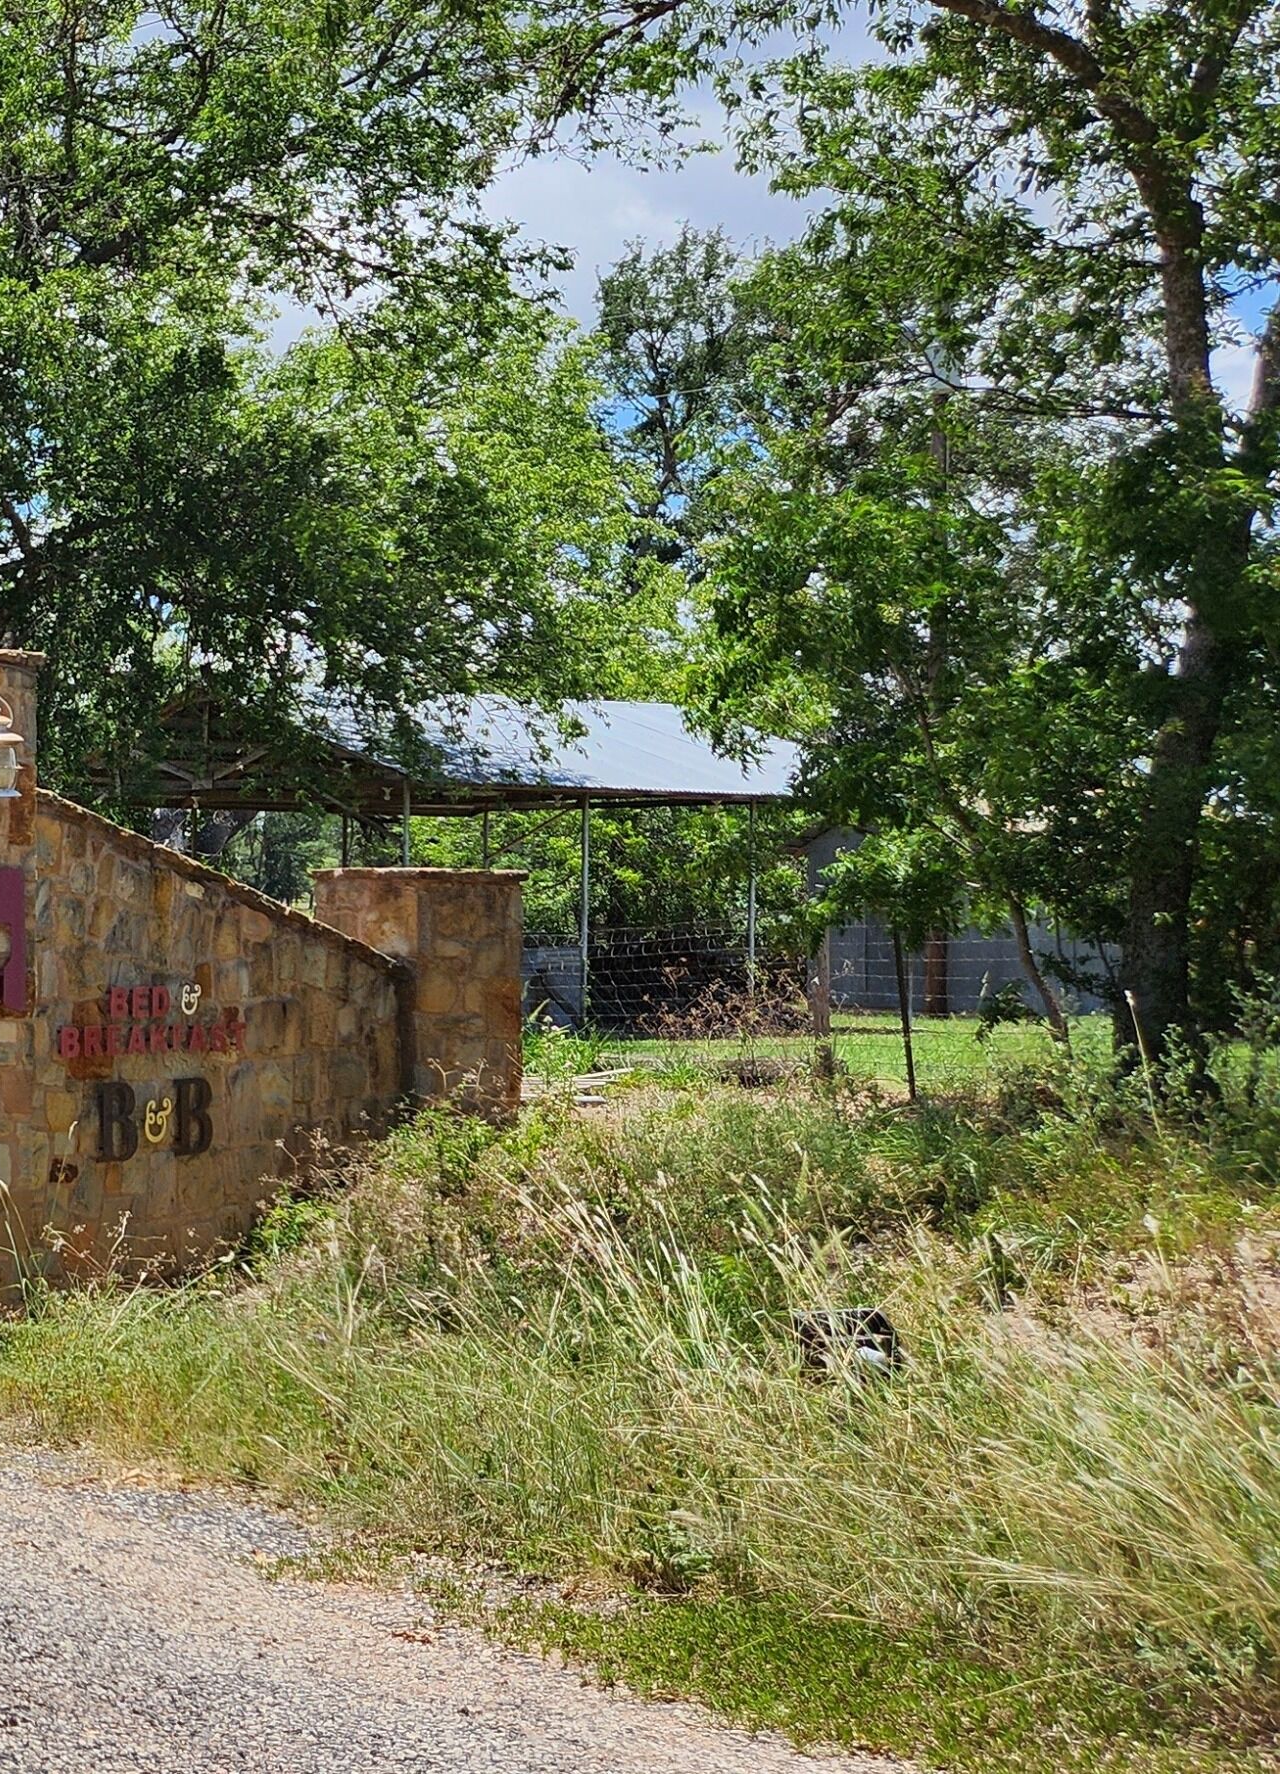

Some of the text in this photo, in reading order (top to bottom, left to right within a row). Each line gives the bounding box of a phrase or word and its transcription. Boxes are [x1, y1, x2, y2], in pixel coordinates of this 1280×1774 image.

[108, 983, 202, 1019] BED &
[58, 1021, 247, 1059] BREAKFAST
